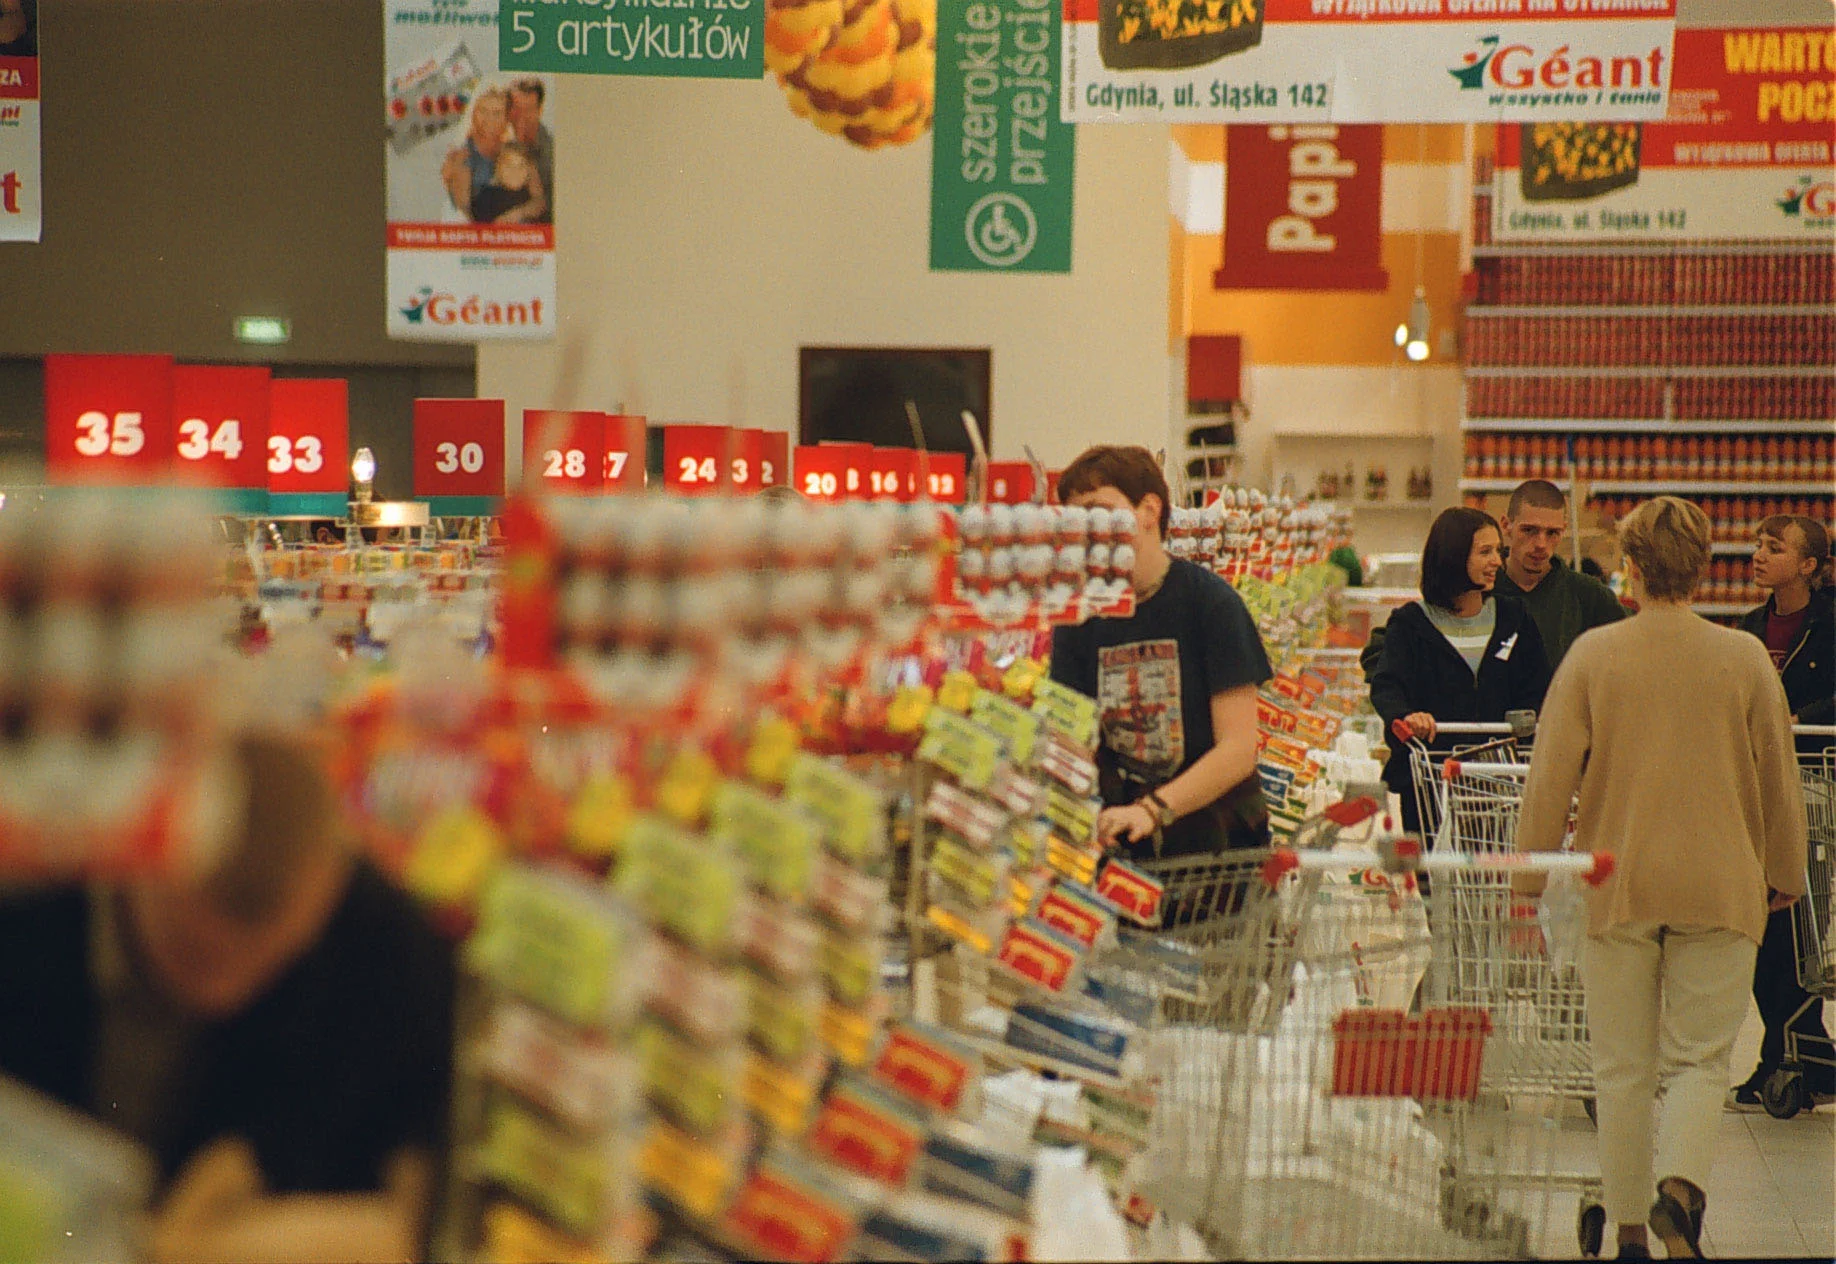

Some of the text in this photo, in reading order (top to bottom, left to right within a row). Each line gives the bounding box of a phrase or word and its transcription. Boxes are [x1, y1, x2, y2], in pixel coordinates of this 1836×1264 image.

[512, 10, 750, 61] 5 artykułów
[1489, 43, 1664, 90] Géant
[956, 3, 1001, 183] szerokie
[1086, 77, 1328, 112] Gdynia, ul. Śląska 142
[427, 293, 543, 326] Géant
[74, 411, 145, 457] 35
[177, 418, 243, 460] 34
[267, 435, 323, 474] 33
[436, 442, 484, 473] 30
[543, 449, 586, 478] 28
[679, 457, 727, 483] 24
[805, 472, 837, 496] 20
[870, 470, 898, 492] 16
[927, 473, 955, 495] 12
